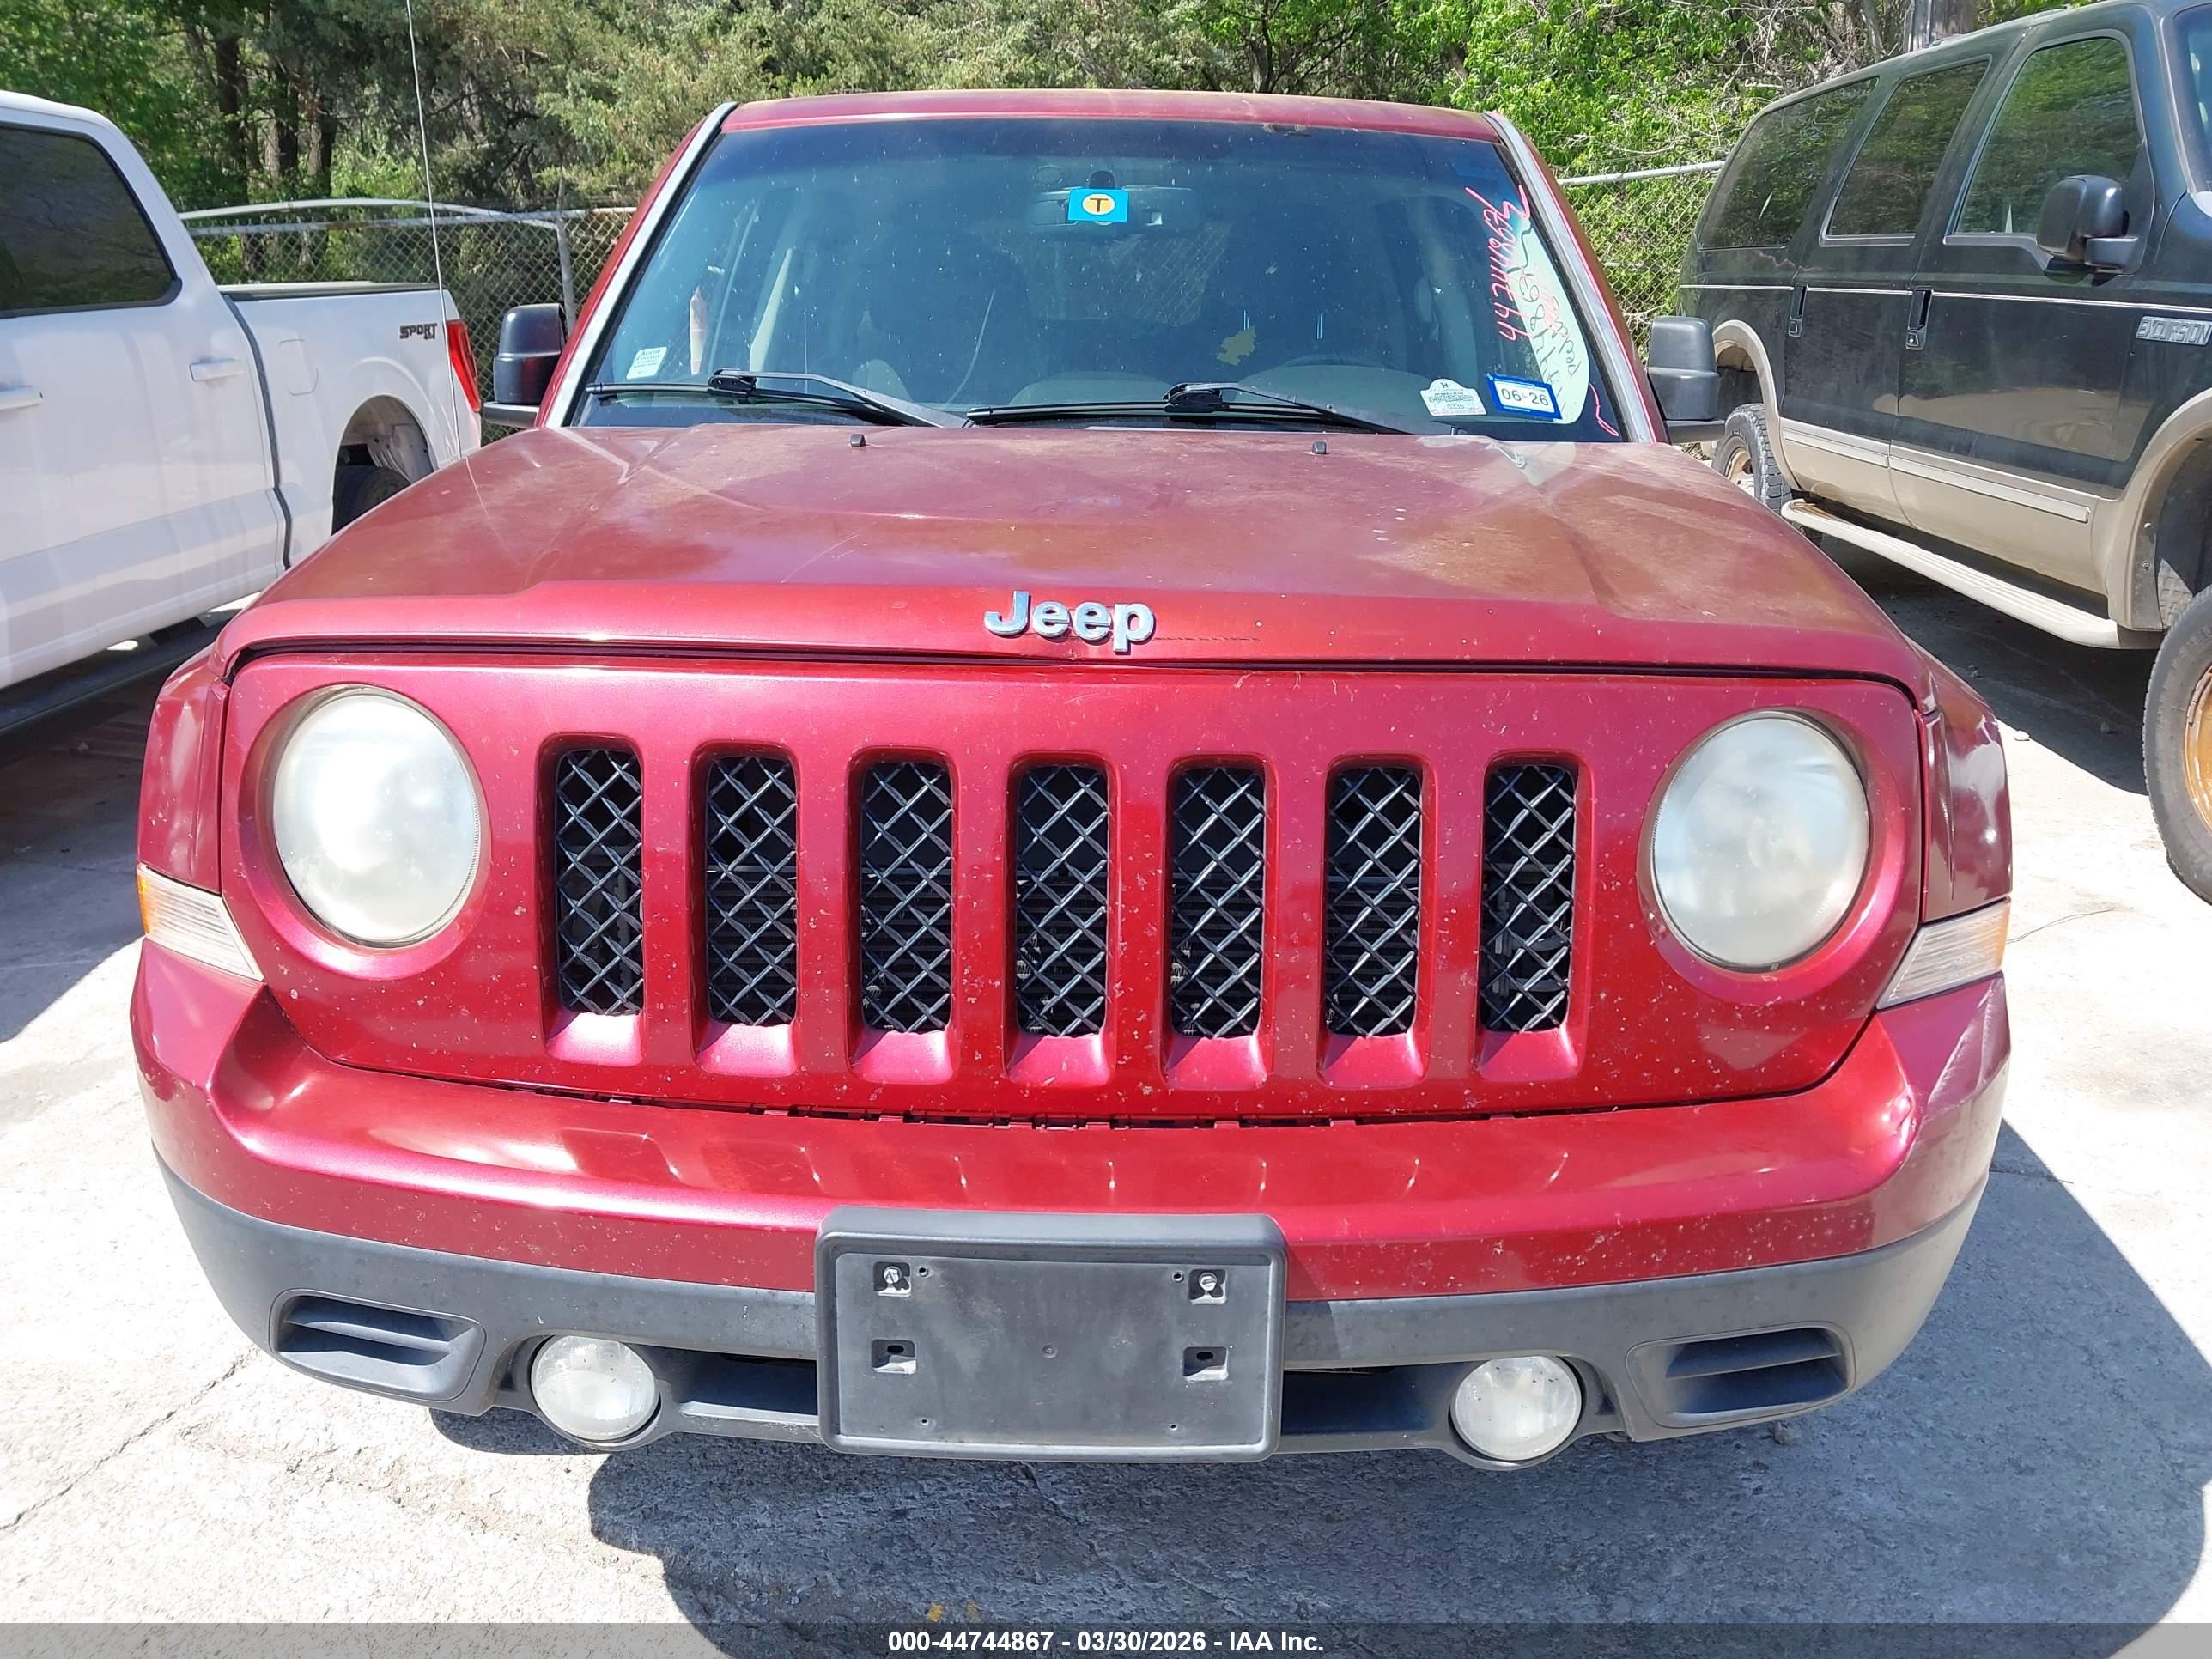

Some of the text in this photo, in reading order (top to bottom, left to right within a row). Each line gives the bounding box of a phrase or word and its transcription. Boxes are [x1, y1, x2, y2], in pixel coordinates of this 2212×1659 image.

[1090, 198, 1109, 212] T
[399, 323, 437, 339] SPORT
[1501, 388, 1522, 402] 06
[1528, 392, 1549, 406] 26
[983, 591, 1155, 653] Jeep
